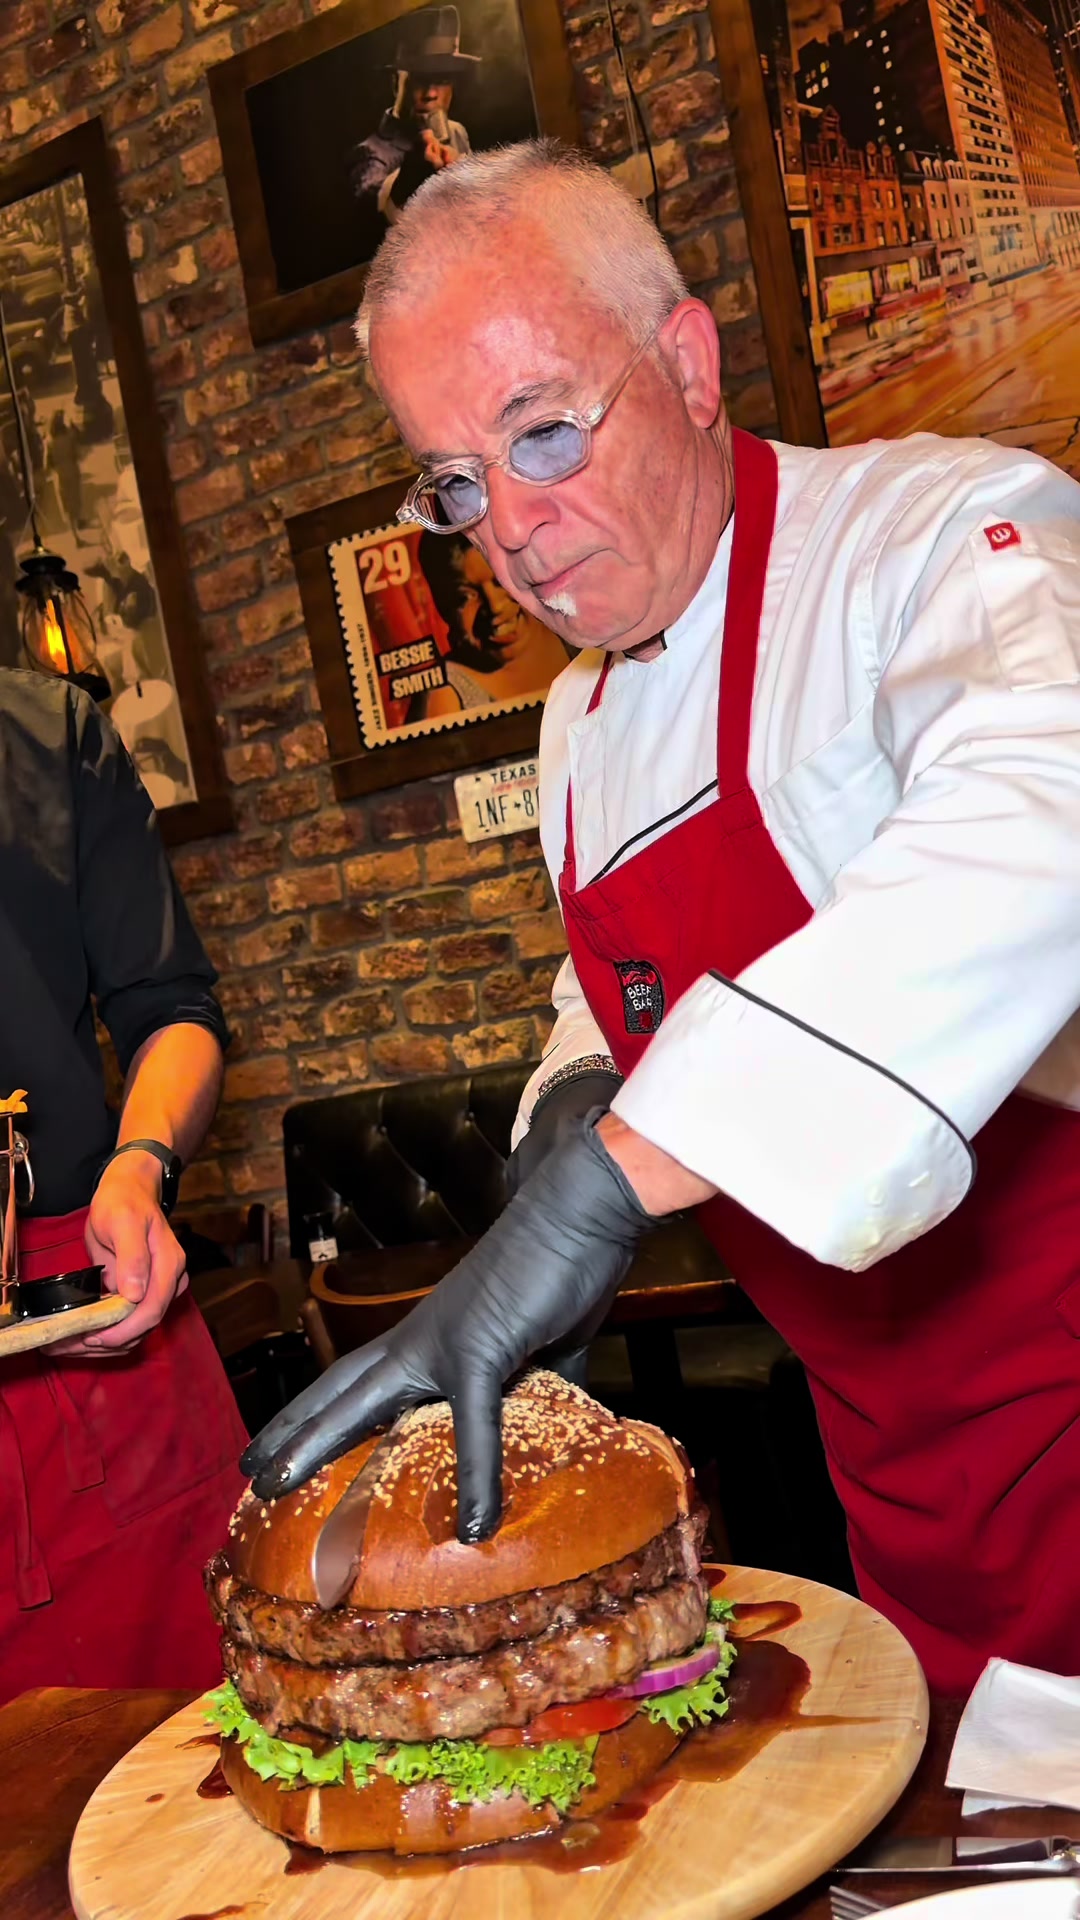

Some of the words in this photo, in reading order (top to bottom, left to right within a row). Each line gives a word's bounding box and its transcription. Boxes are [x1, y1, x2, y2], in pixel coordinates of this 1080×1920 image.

[359, 541, 411, 594] 29
[379, 640, 435, 673] BESSIE
[391, 667, 445, 699] SMITH
[491, 763, 537, 784] TEXAS
[626, 983, 652, 999] BEEF
[632, 998, 653, 1012] BAR
